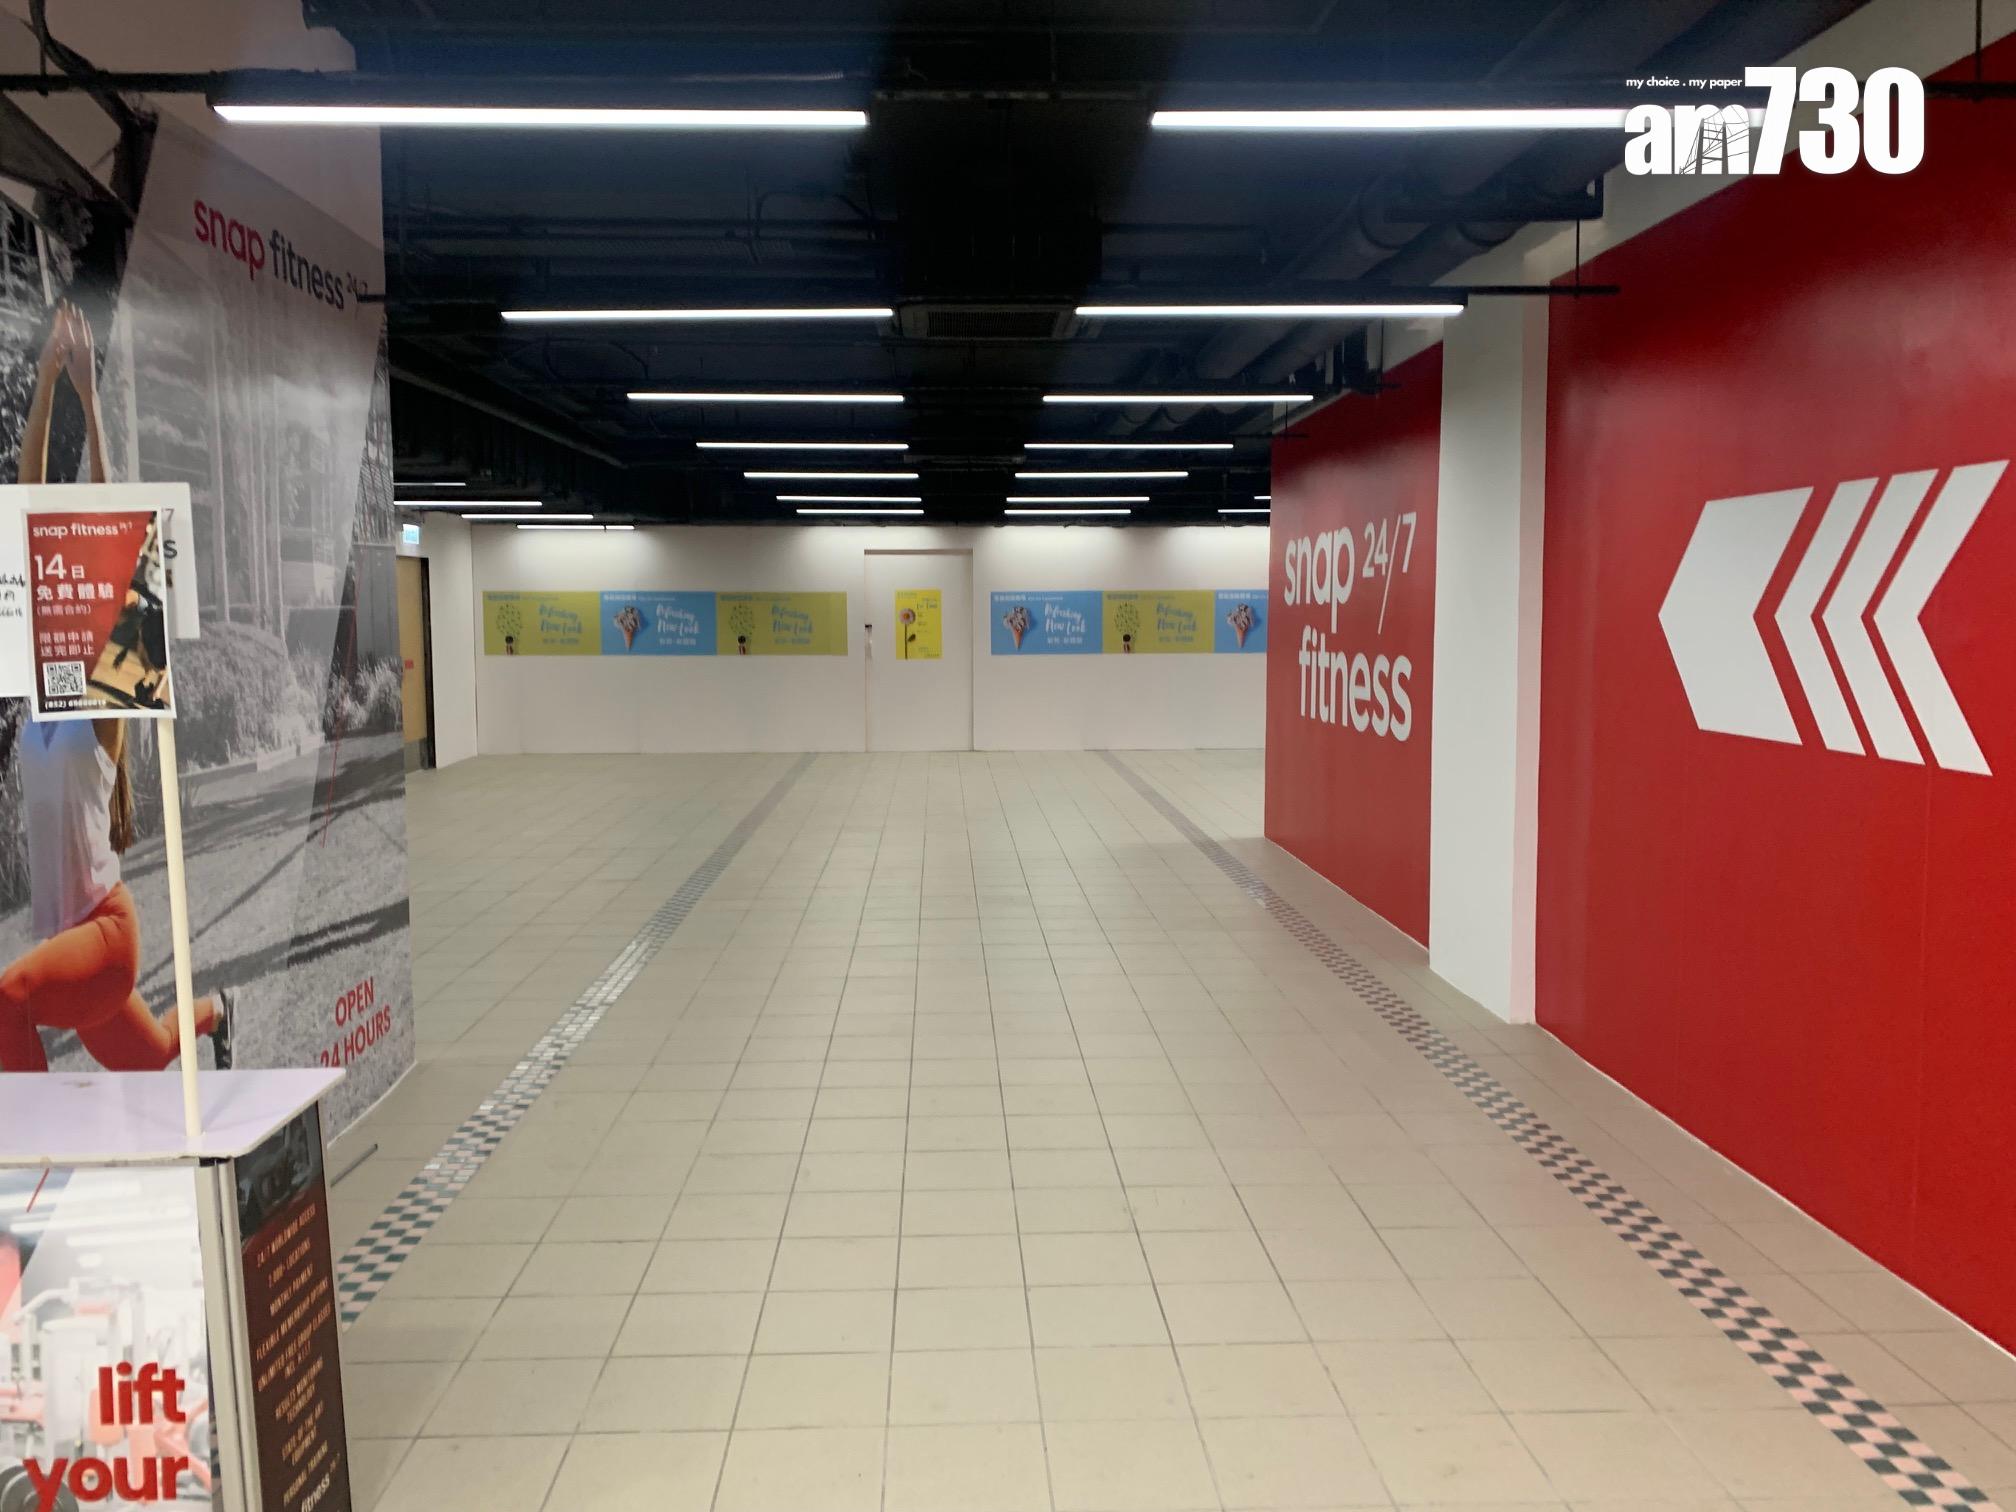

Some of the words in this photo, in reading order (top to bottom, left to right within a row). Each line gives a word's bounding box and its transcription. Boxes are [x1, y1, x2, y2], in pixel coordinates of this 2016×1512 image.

[193, 199, 265, 281] snap
[269, 229, 345, 310] fitness
[32, 526, 68, 539] snap
[70, 522, 119, 537] fitness
[1284, 526, 1355, 634] snap
[1362, 511, 1417, 635] 24/7
[1298, 625, 1413, 742] fitness
[335, 975, 374, 1028] OPEN
[344, 1004, 391, 1066] HOURS
[98, 1362, 186, 1426] lift
[22, 1456, 189, 1512] your
